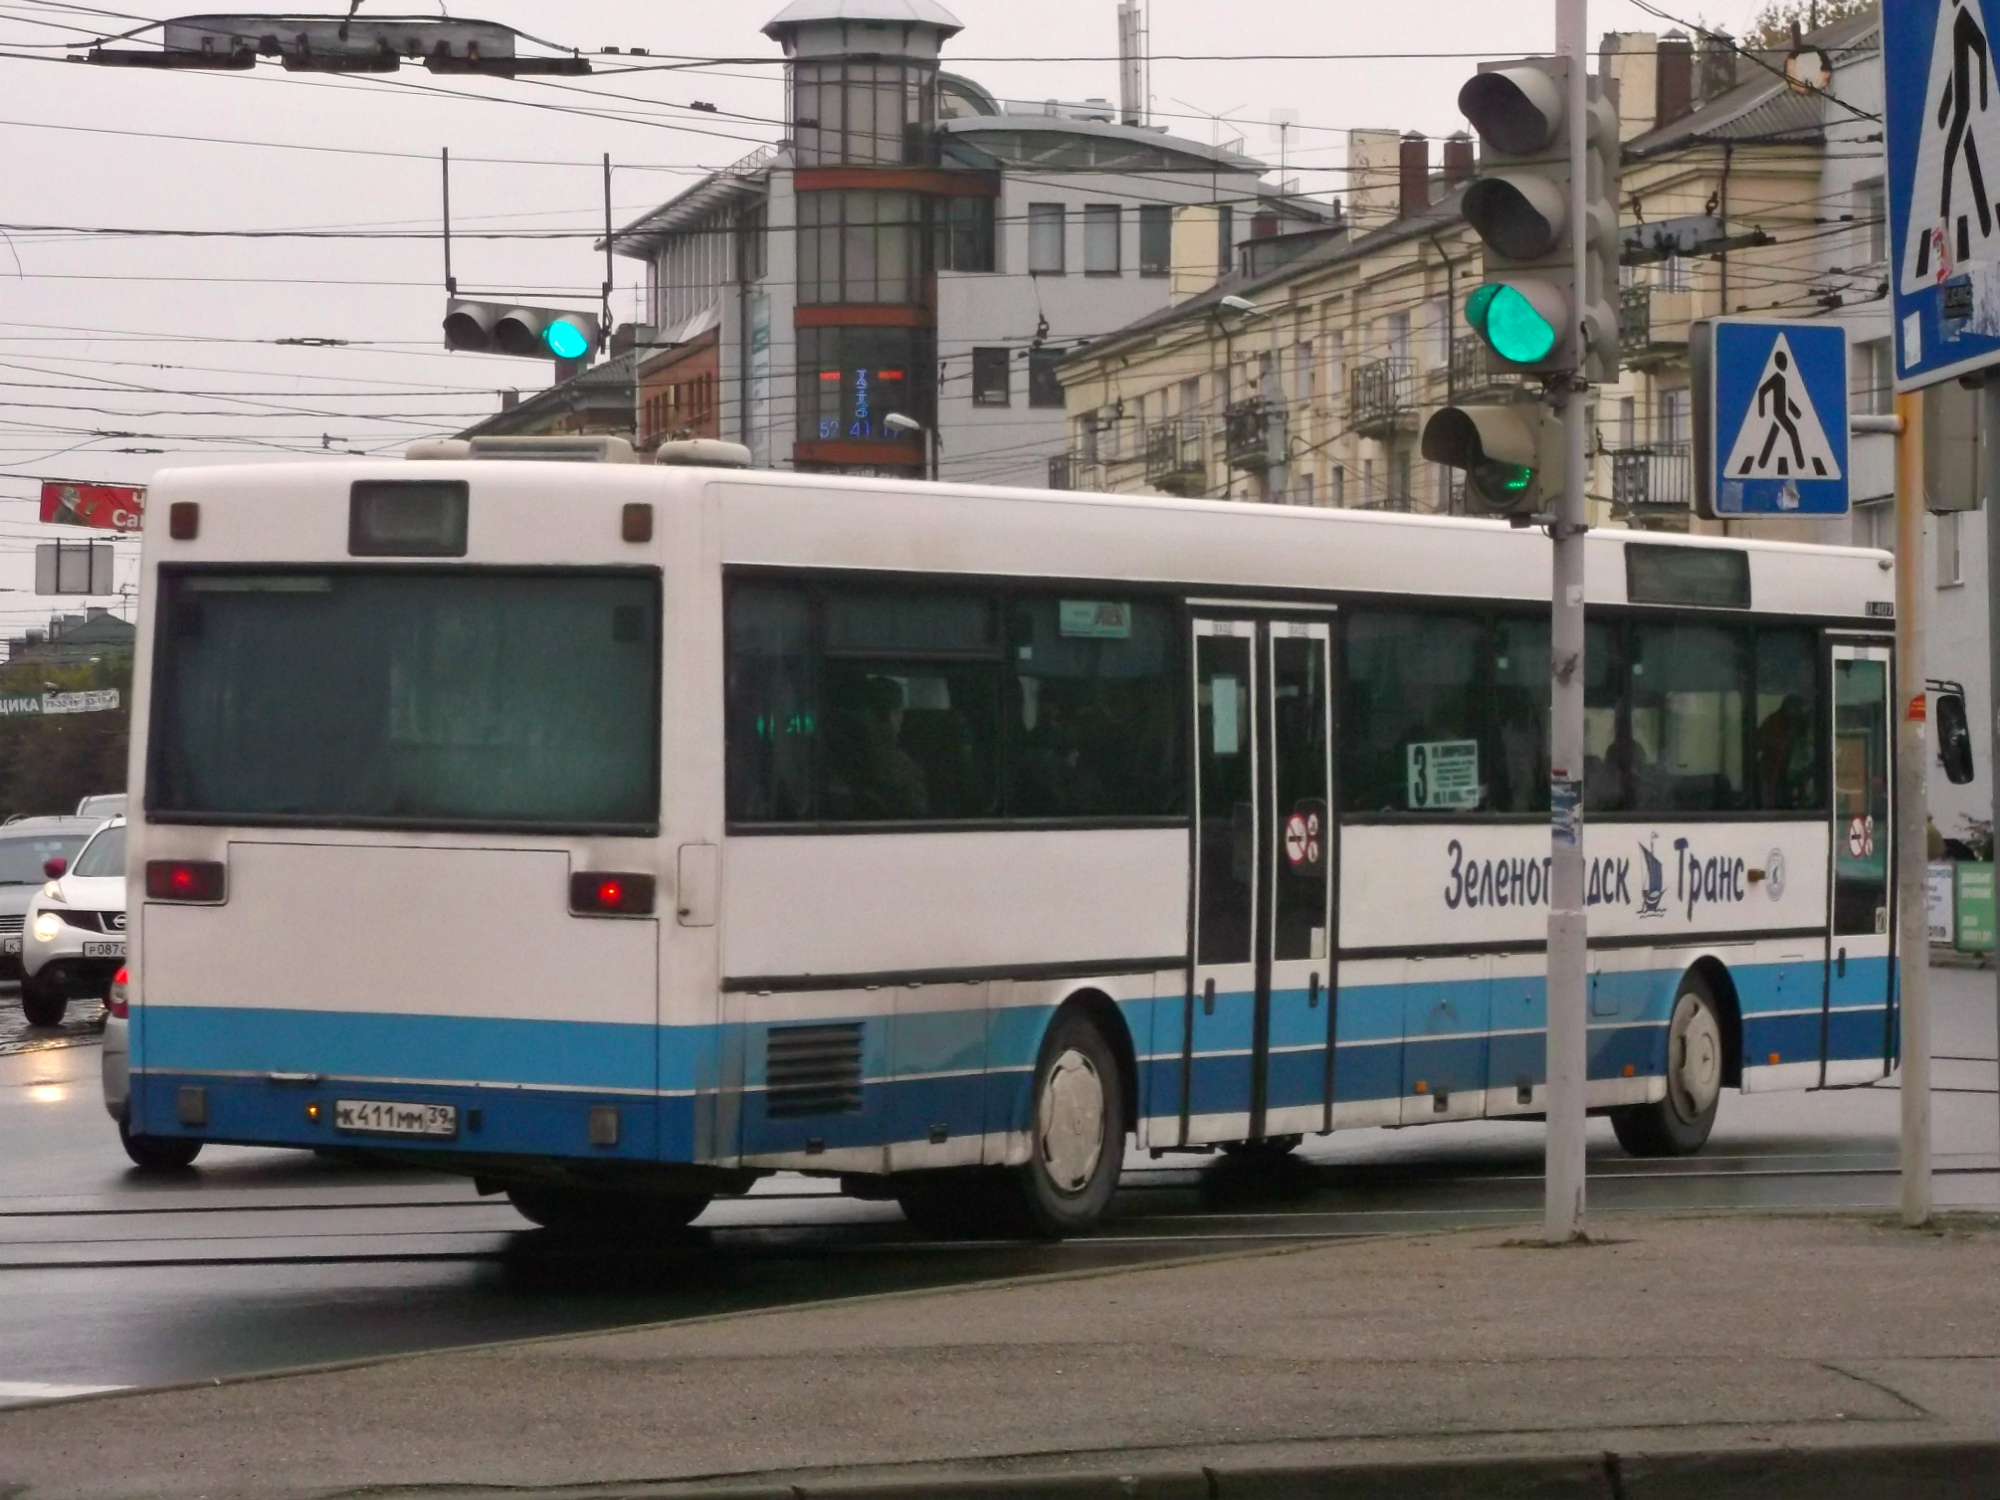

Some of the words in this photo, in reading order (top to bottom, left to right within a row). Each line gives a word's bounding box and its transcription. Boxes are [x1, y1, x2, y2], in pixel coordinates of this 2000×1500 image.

[849, 422, 870, 436] 41
[112, 509, 144, 528] Са
[1413, 745, 1428, 807] 3
[1445, 839, 1631, 910] Зеленогдск
[1673, 837, 1745, 923] Транс
[428, 1107, 448, 1124] 39
